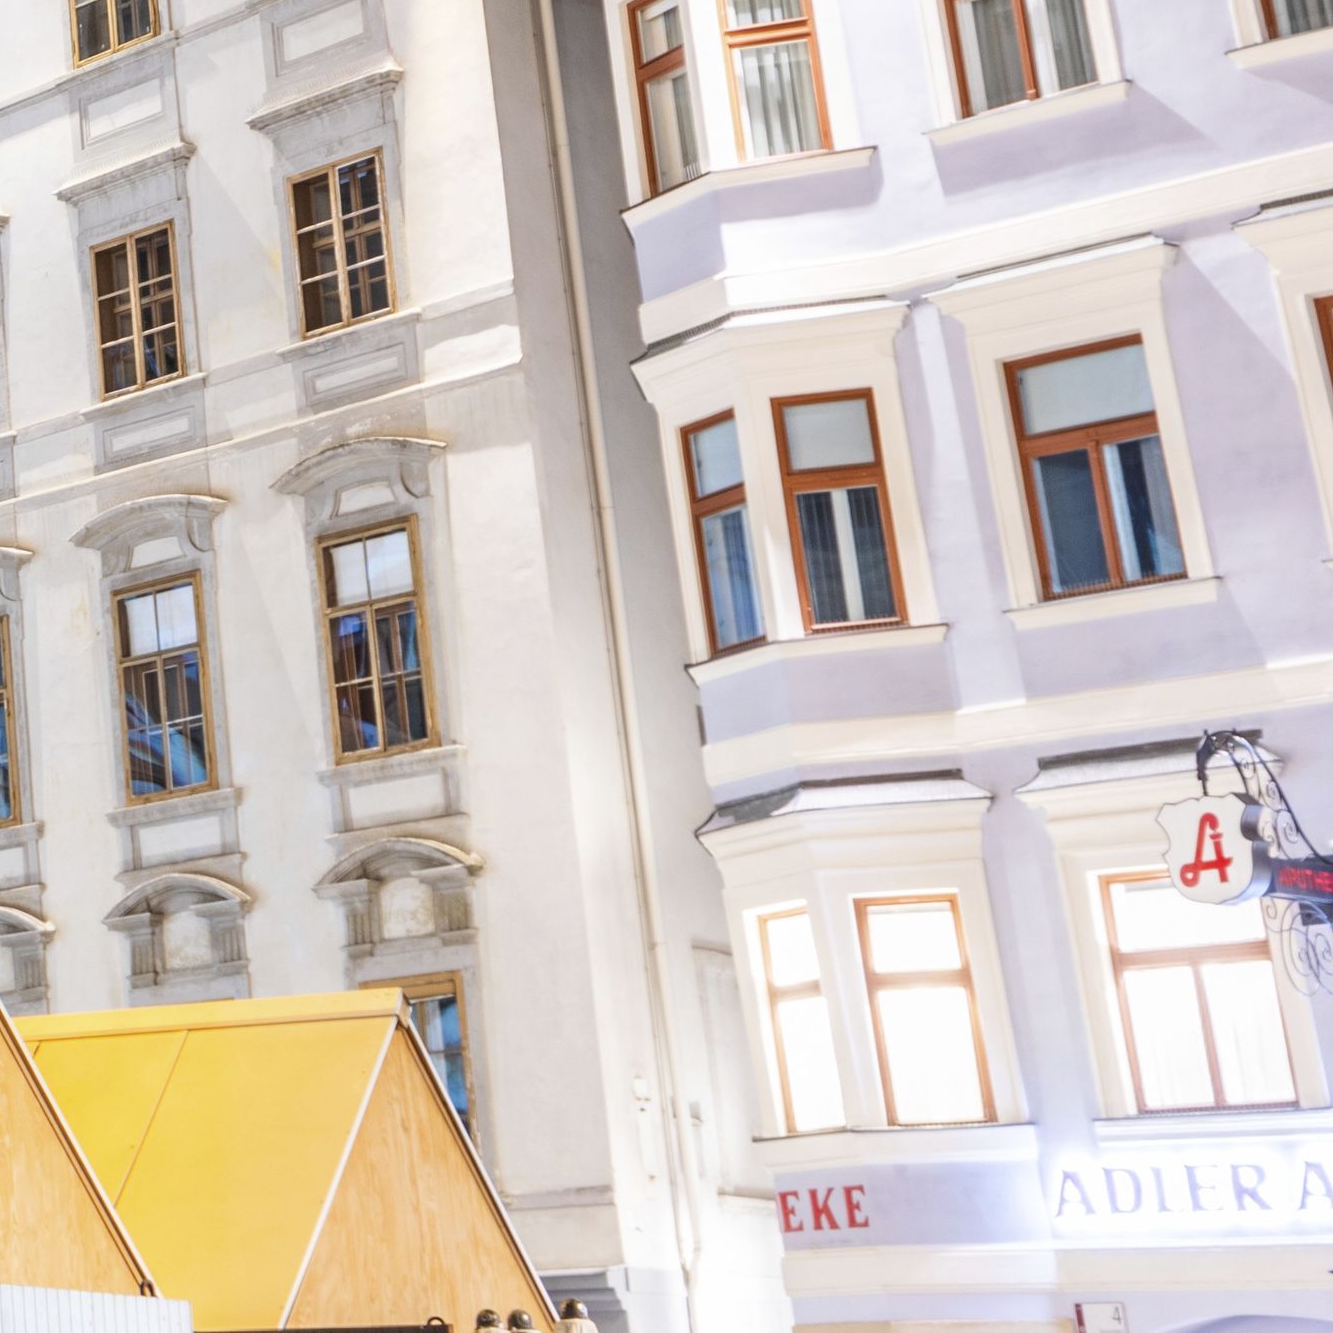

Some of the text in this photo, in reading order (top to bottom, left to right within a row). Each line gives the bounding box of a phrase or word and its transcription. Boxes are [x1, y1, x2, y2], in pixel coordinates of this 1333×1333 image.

[1180, 812, 1233, 887] A
[778, 1184, 870, 1233] EKE
[1056, 1164, 1273, 1218] ADLER
